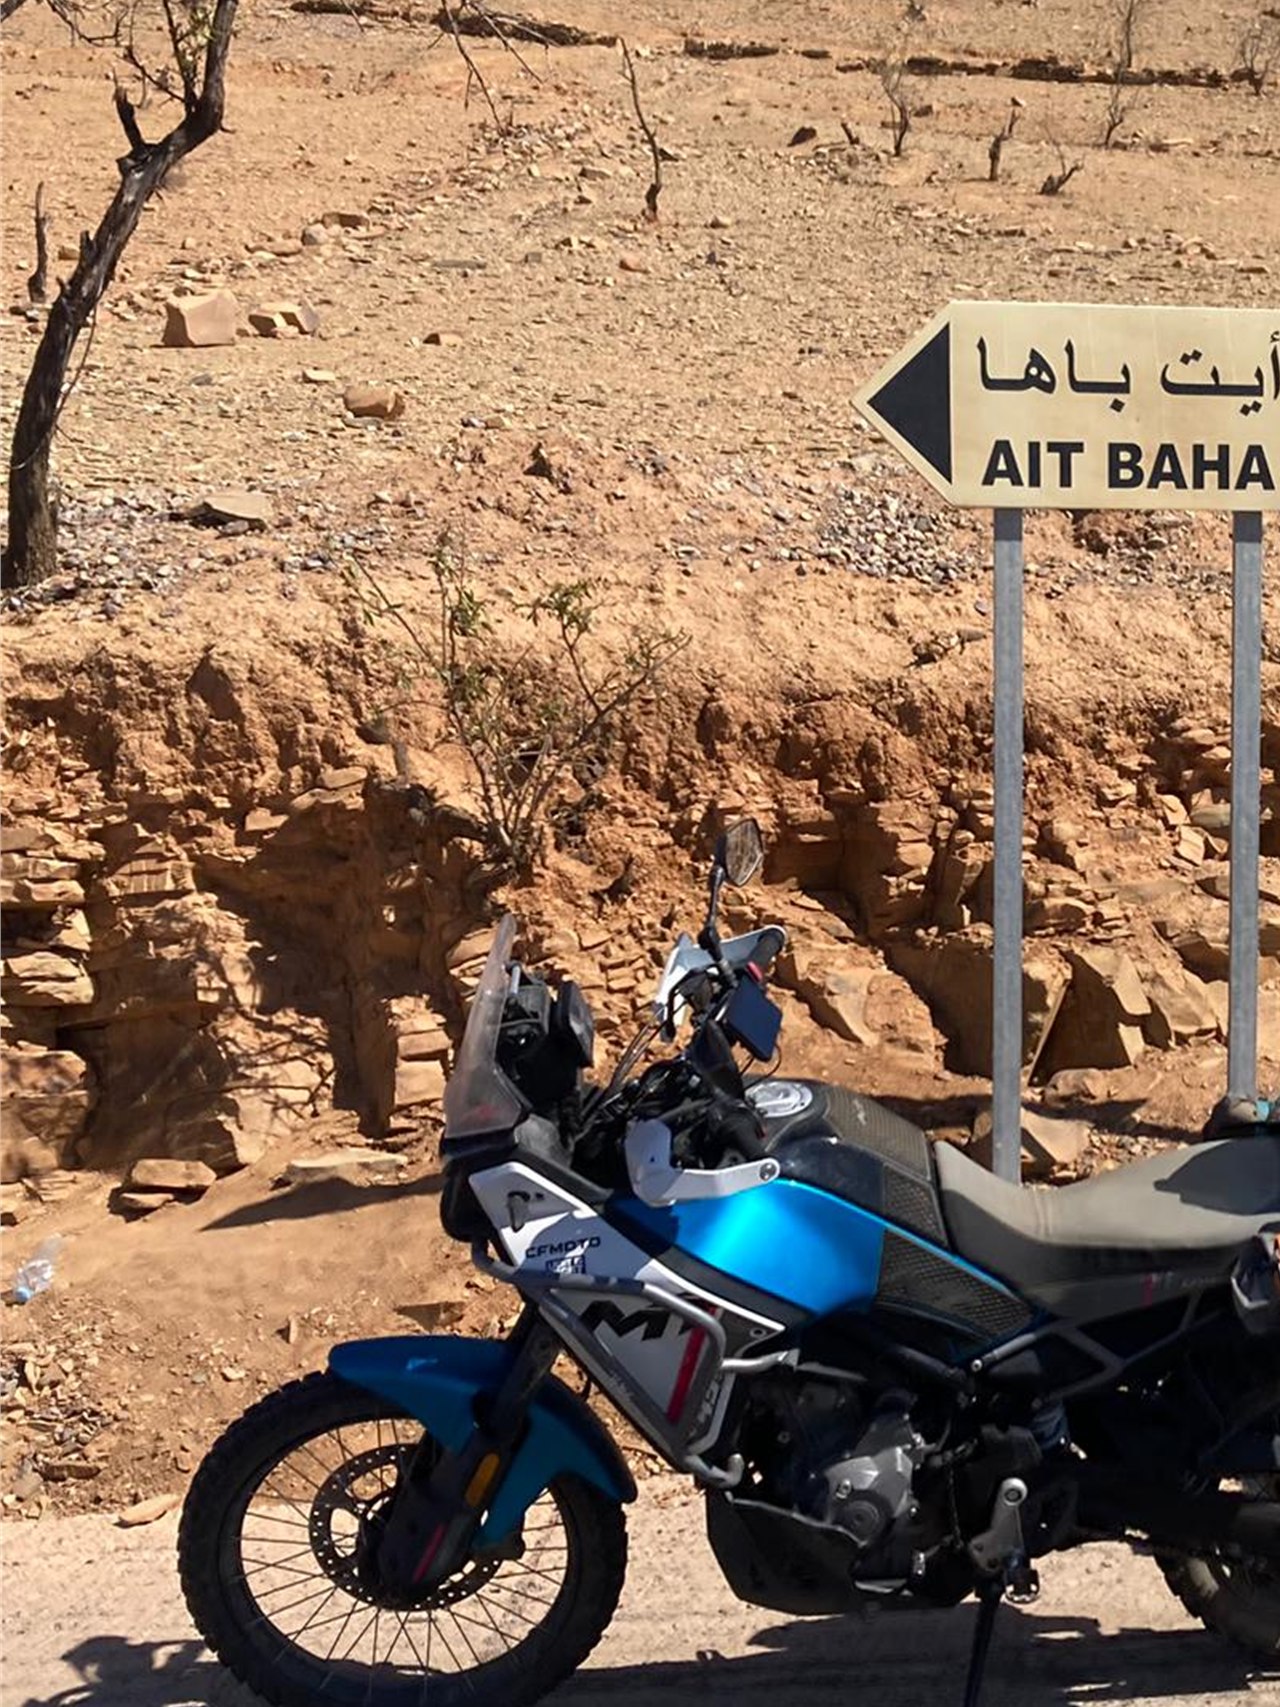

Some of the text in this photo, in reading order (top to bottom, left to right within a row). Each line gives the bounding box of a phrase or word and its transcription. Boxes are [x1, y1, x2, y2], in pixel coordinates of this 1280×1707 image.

[976, 335, 1131, 413] باها
[981, 439, 1276, 491] AIT BAHA
[525, 1236, 601, 1259] CFMOTO
